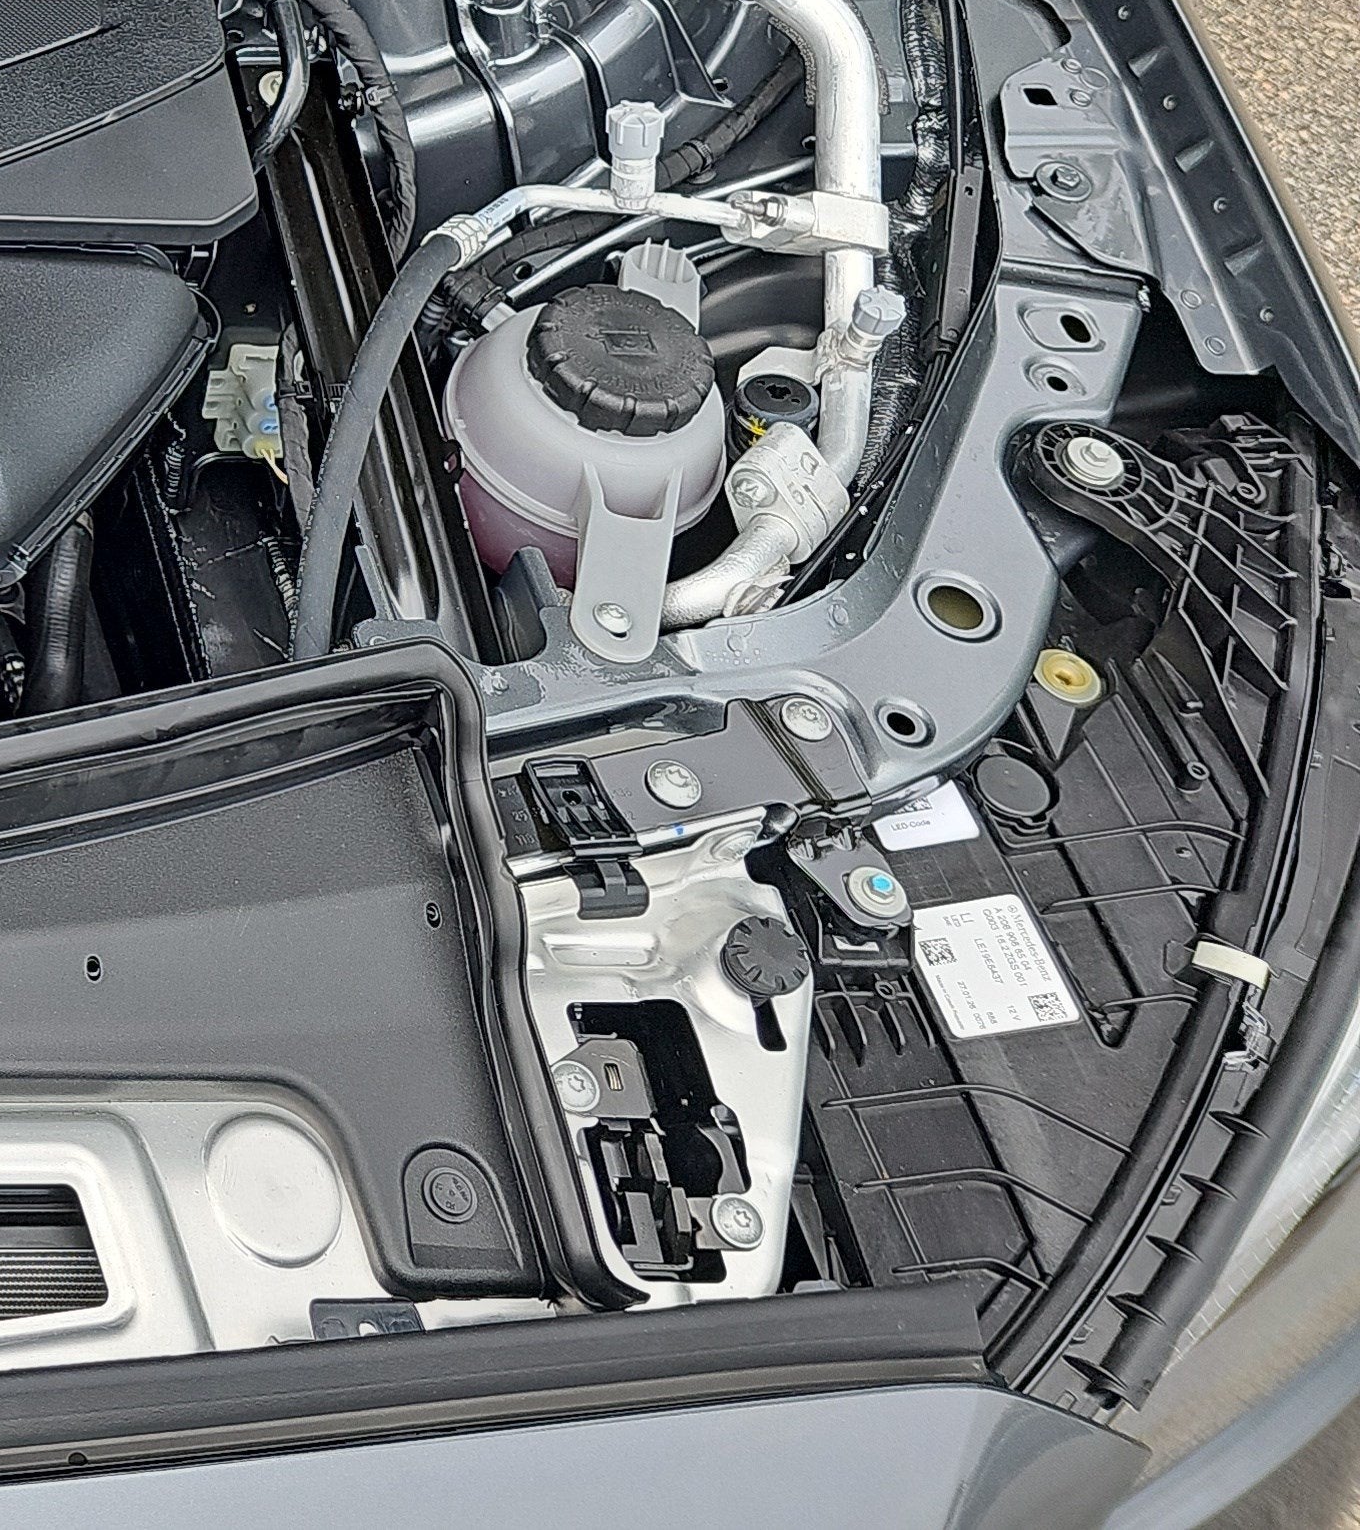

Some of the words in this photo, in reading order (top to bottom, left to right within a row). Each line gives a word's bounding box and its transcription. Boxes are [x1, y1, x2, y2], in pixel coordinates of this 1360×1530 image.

[959, 911, 974, 923] LI
[1006, 1004, 1017, 1014] 12
[1014, 914, 1051, 982] Mercedes-Benz
